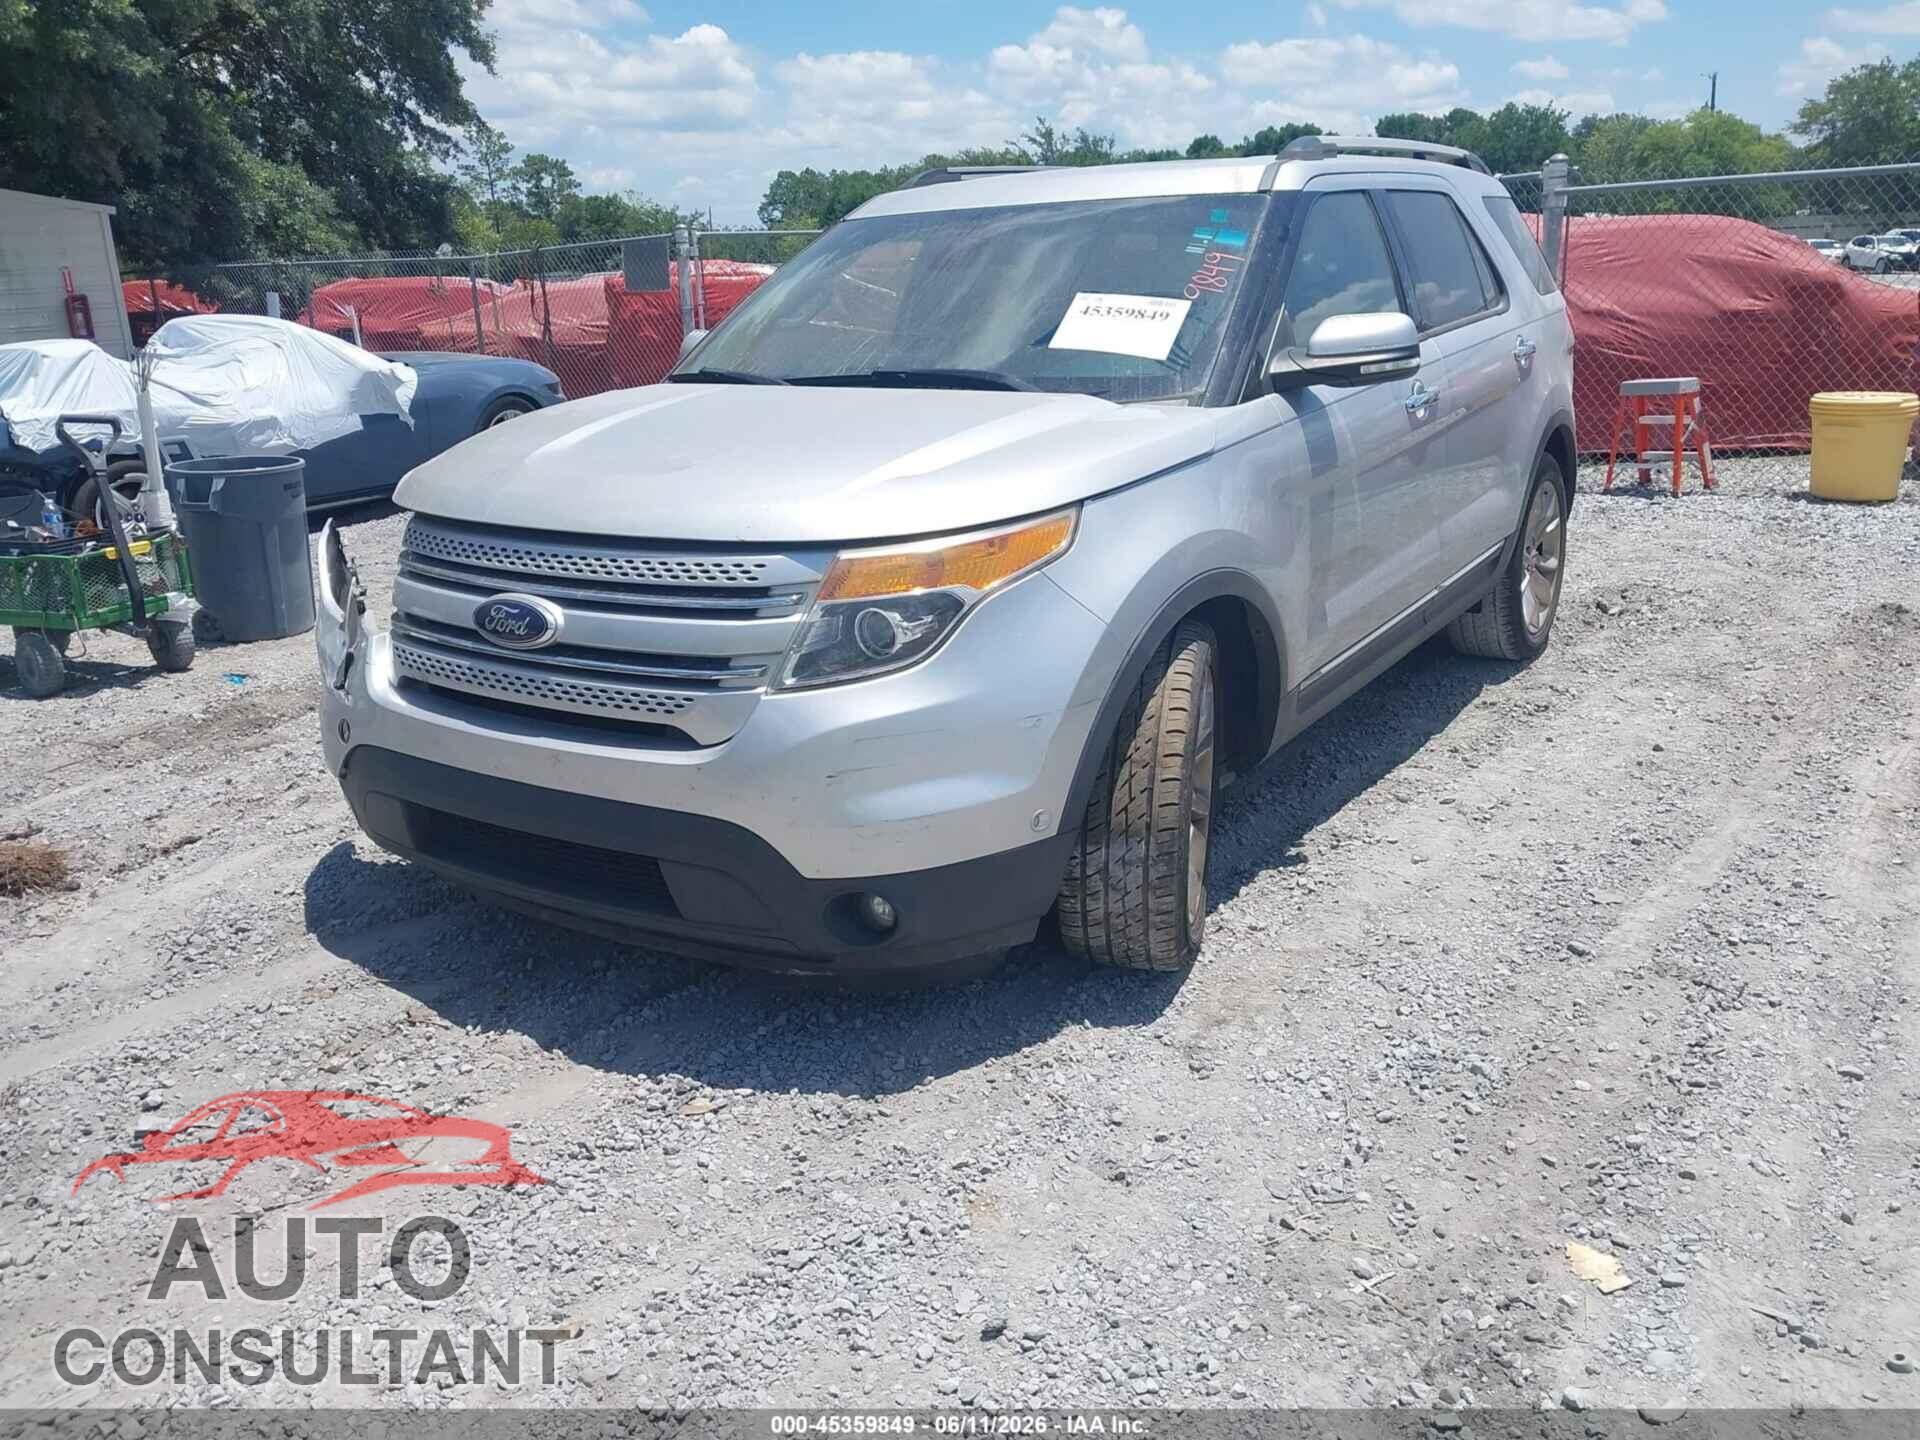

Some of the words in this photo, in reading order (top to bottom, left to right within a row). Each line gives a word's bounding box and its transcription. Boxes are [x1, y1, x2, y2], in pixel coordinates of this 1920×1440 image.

[1184, 252, 1246, 299] 9849
[1080, 305, 1170, 320] 45359849
[484, 605, 530, 636] Ford
